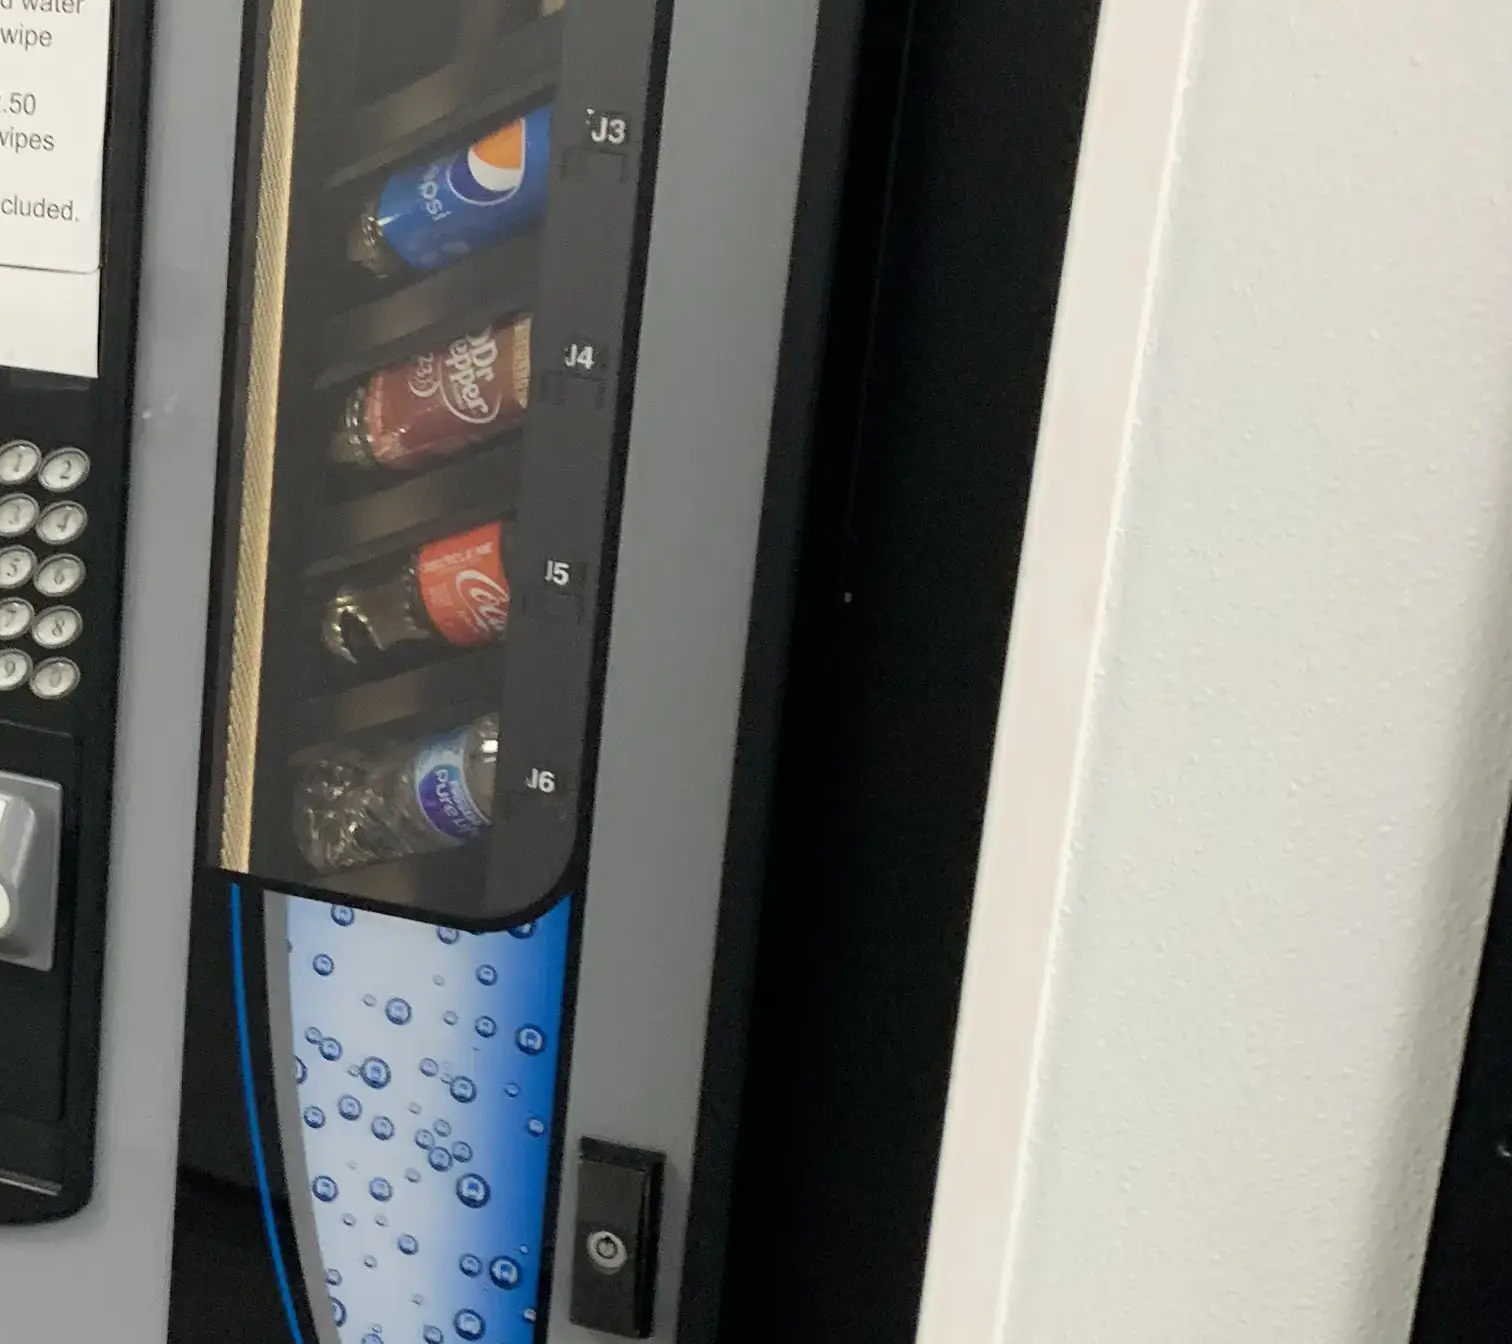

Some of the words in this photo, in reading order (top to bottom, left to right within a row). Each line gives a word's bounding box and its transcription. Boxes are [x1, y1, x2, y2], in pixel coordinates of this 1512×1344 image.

[590, 115, 626, 145] J3
[564, 344, 596, 370] J4
[445, 338, 490, 414] epper
[59, 458, 74, 480] 2
[525, 767, 556, 793] J6
